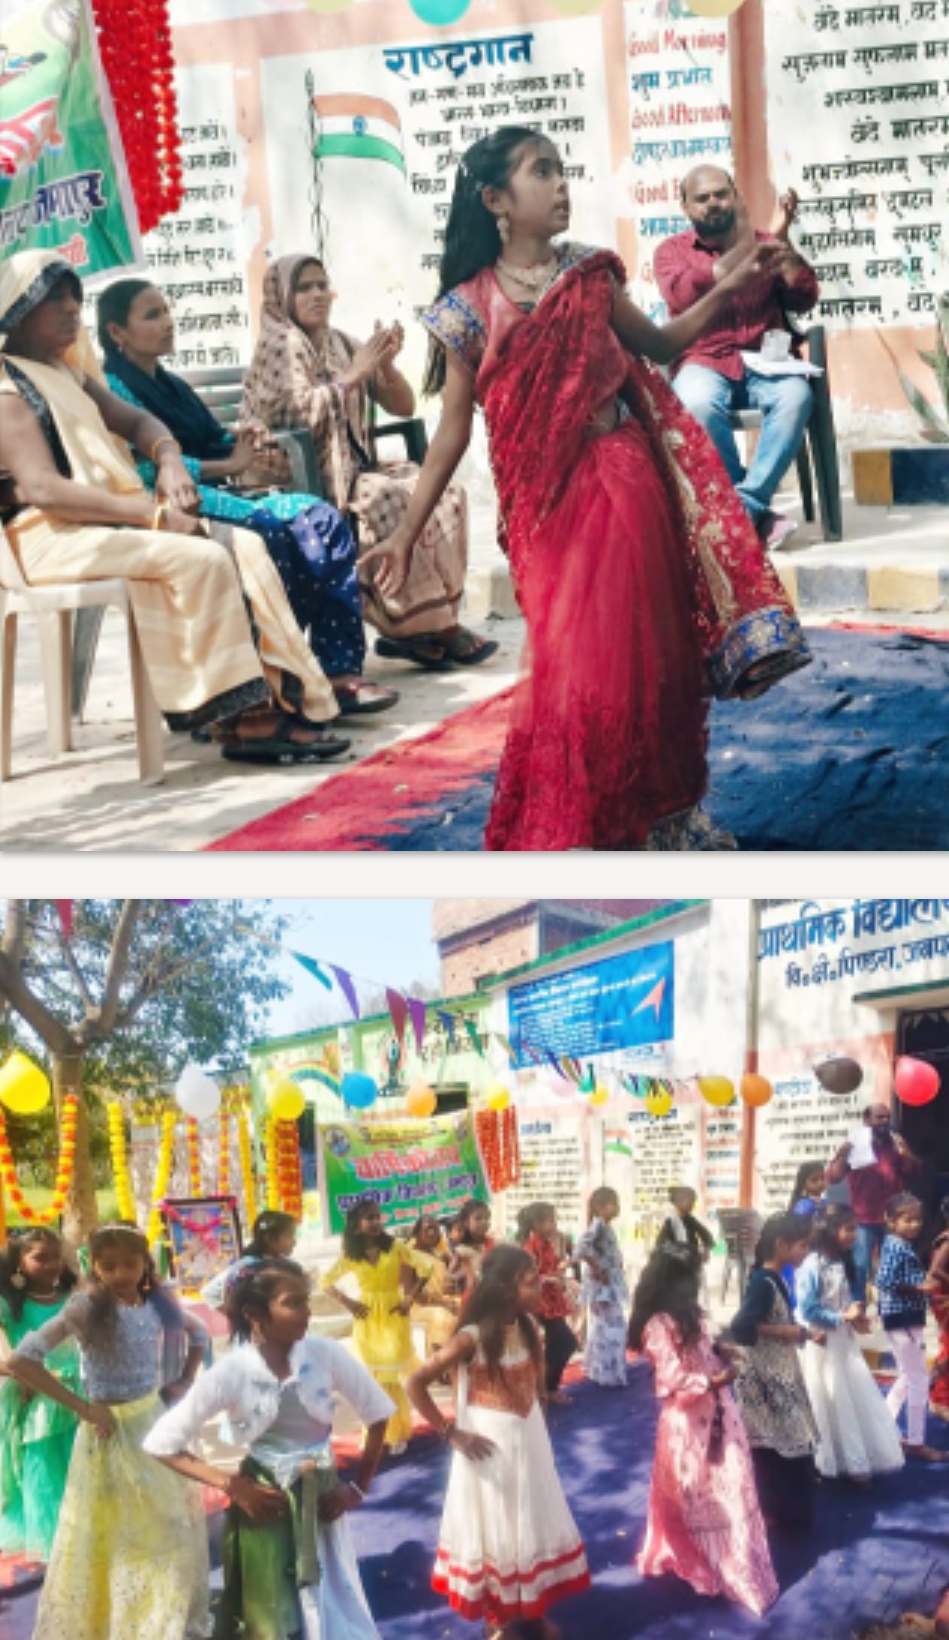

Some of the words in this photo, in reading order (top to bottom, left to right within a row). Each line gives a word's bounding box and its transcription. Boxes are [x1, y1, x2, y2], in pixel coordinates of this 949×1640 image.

[629, 31, 660, 57] Good
[631, 104, 665, 130] Good
[757, 901, 846, 961] प्राथमिक
